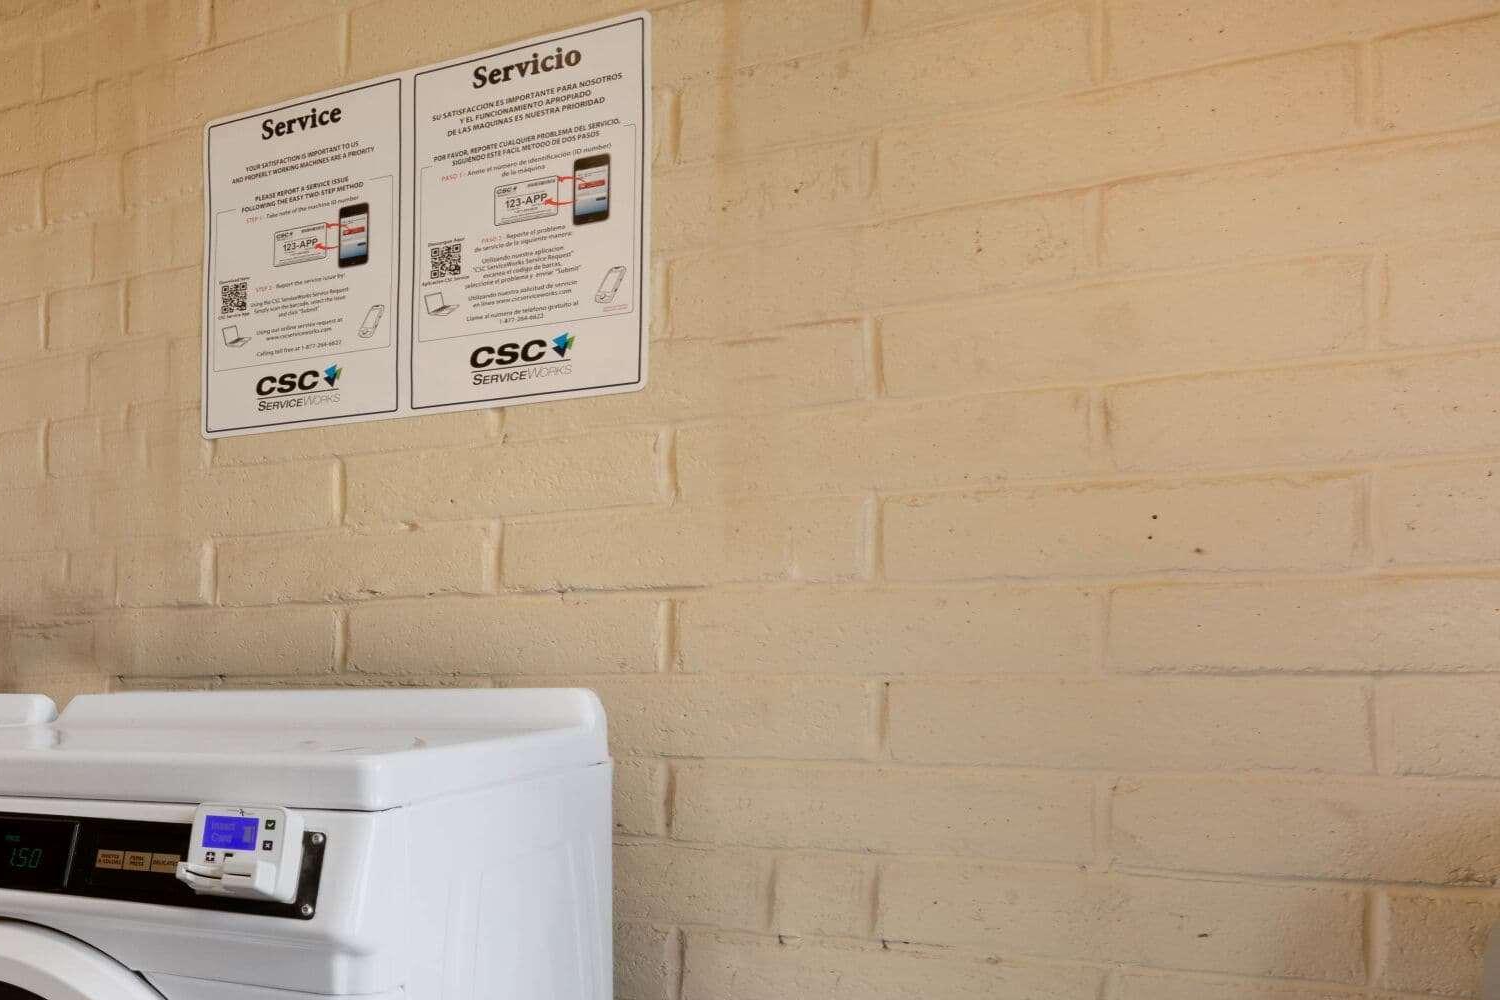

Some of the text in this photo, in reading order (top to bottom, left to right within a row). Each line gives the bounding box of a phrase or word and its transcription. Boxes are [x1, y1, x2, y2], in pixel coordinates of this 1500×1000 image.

[472, 47, 581, 89] Servicio
[432, 113, 442, 122] SU
[495, 99, 505, 107] ES
[505, 87, 555, 105] IMPORTANTE
[556, 82, 578, 94] PARA
[578, 72, 623, 89] NOSOTROS
[459, 89, 592, 125] Y EL FUNCIONAMIENTO APROPIADO
[261, 107, 342, 140] Service
[447, 129, 457, 138] DE
[457, 125, 472, 135] LAS
[514, 114, 524, 122] ES
[524, 106, 560, 120] NUESTRA
[561, 96, 606, 112] PRIORIDAD
[245, 140, 359, 173] YOUR SATISFACTION IS IMPORTANT TO US
[433, 154, 446, 163] POR
[470, 143, 498, 155] REPORTE
[498, 135, 536, 149] CUALQUIER
[536, 127, 573, 141] PROBLEMA
[573, 125, 587, 134] DEL
[451, 153, 486, 167] SIGUIENDO
[486, 150, 502, 159] ESTE
[551, 137, 561, 146] DE
[561, 134, 578, 144] DOS
[577, 129, 601, 141] PASOS
[231, 176, 244, 185] AND
[244, 169, 272, 182] PROPERLY
[272, 163, 300, 175] WORKING
[299, 156, 330, 169] MACHINES
[330, 153, 342, 162] ARE
[347, 146, 375, 158] PRIORITY
[241, 200, 276, 214] FOLLOWING
[277, 197, 289, 206] THE
[289, 194, 304, 203] EASY
[336, 181, 364, 193] METHOD
[255, 175, 349, 202] PLEASE REPORT A SERVICE ISSUE
[505, 192, 548, 209] 123-APP
[282, 237, 319, 252] 123-APP
[470, 339, 547, 369] CSC
[256, 370, 320, 396] CSC
